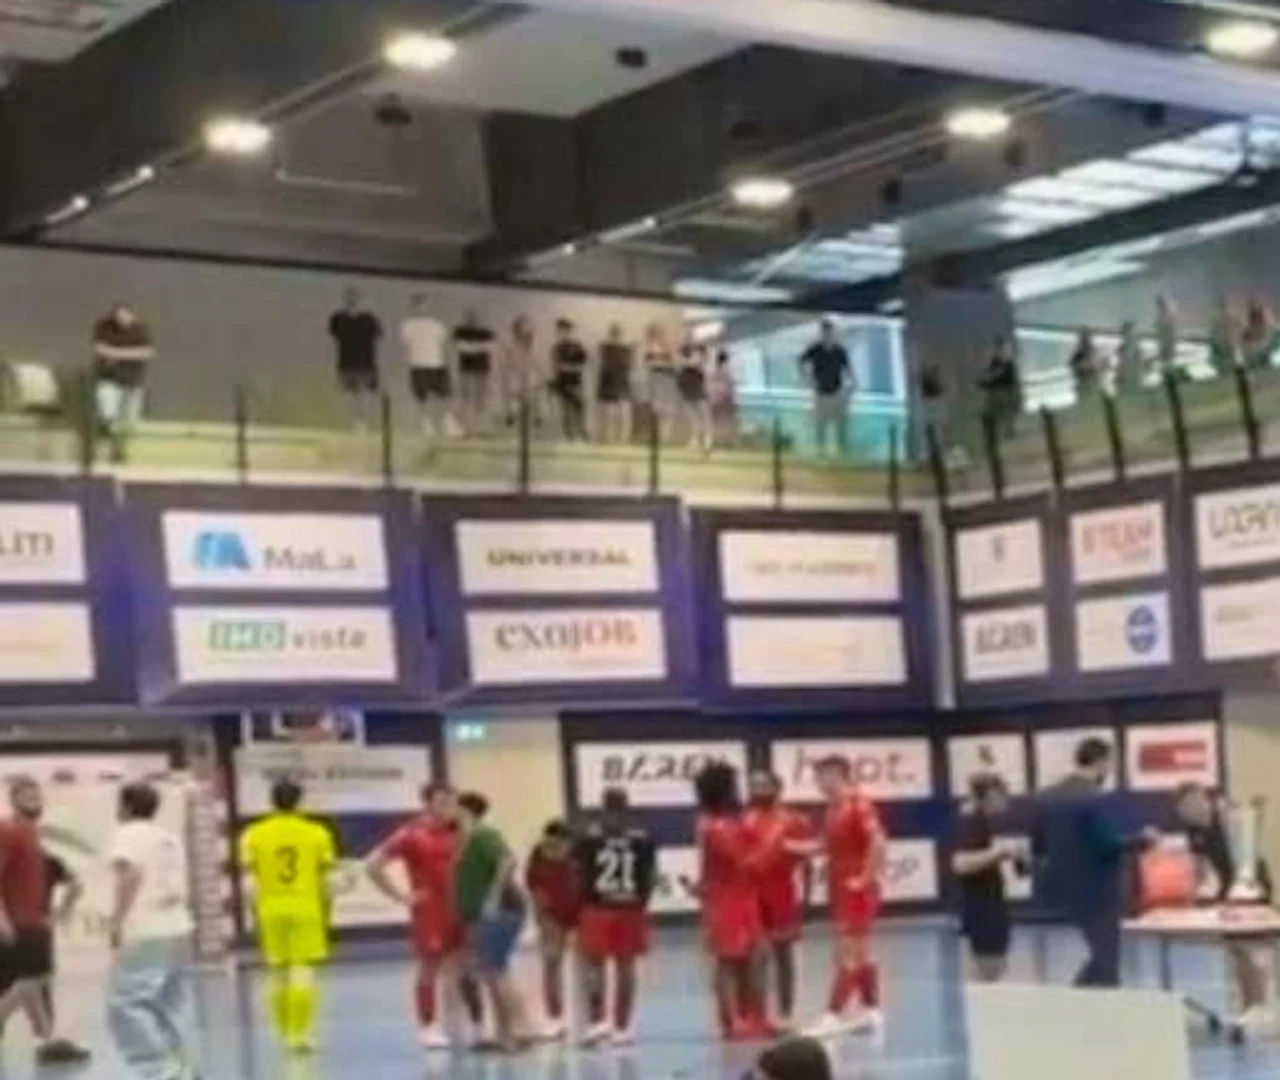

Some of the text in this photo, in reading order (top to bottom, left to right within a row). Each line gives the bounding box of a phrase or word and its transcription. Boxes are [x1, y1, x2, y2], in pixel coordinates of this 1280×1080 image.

[486, 546, 632, 567] UNIVERSAL
[273, 845, 299, 885] 3
[594, 846, 638, 896] 21
